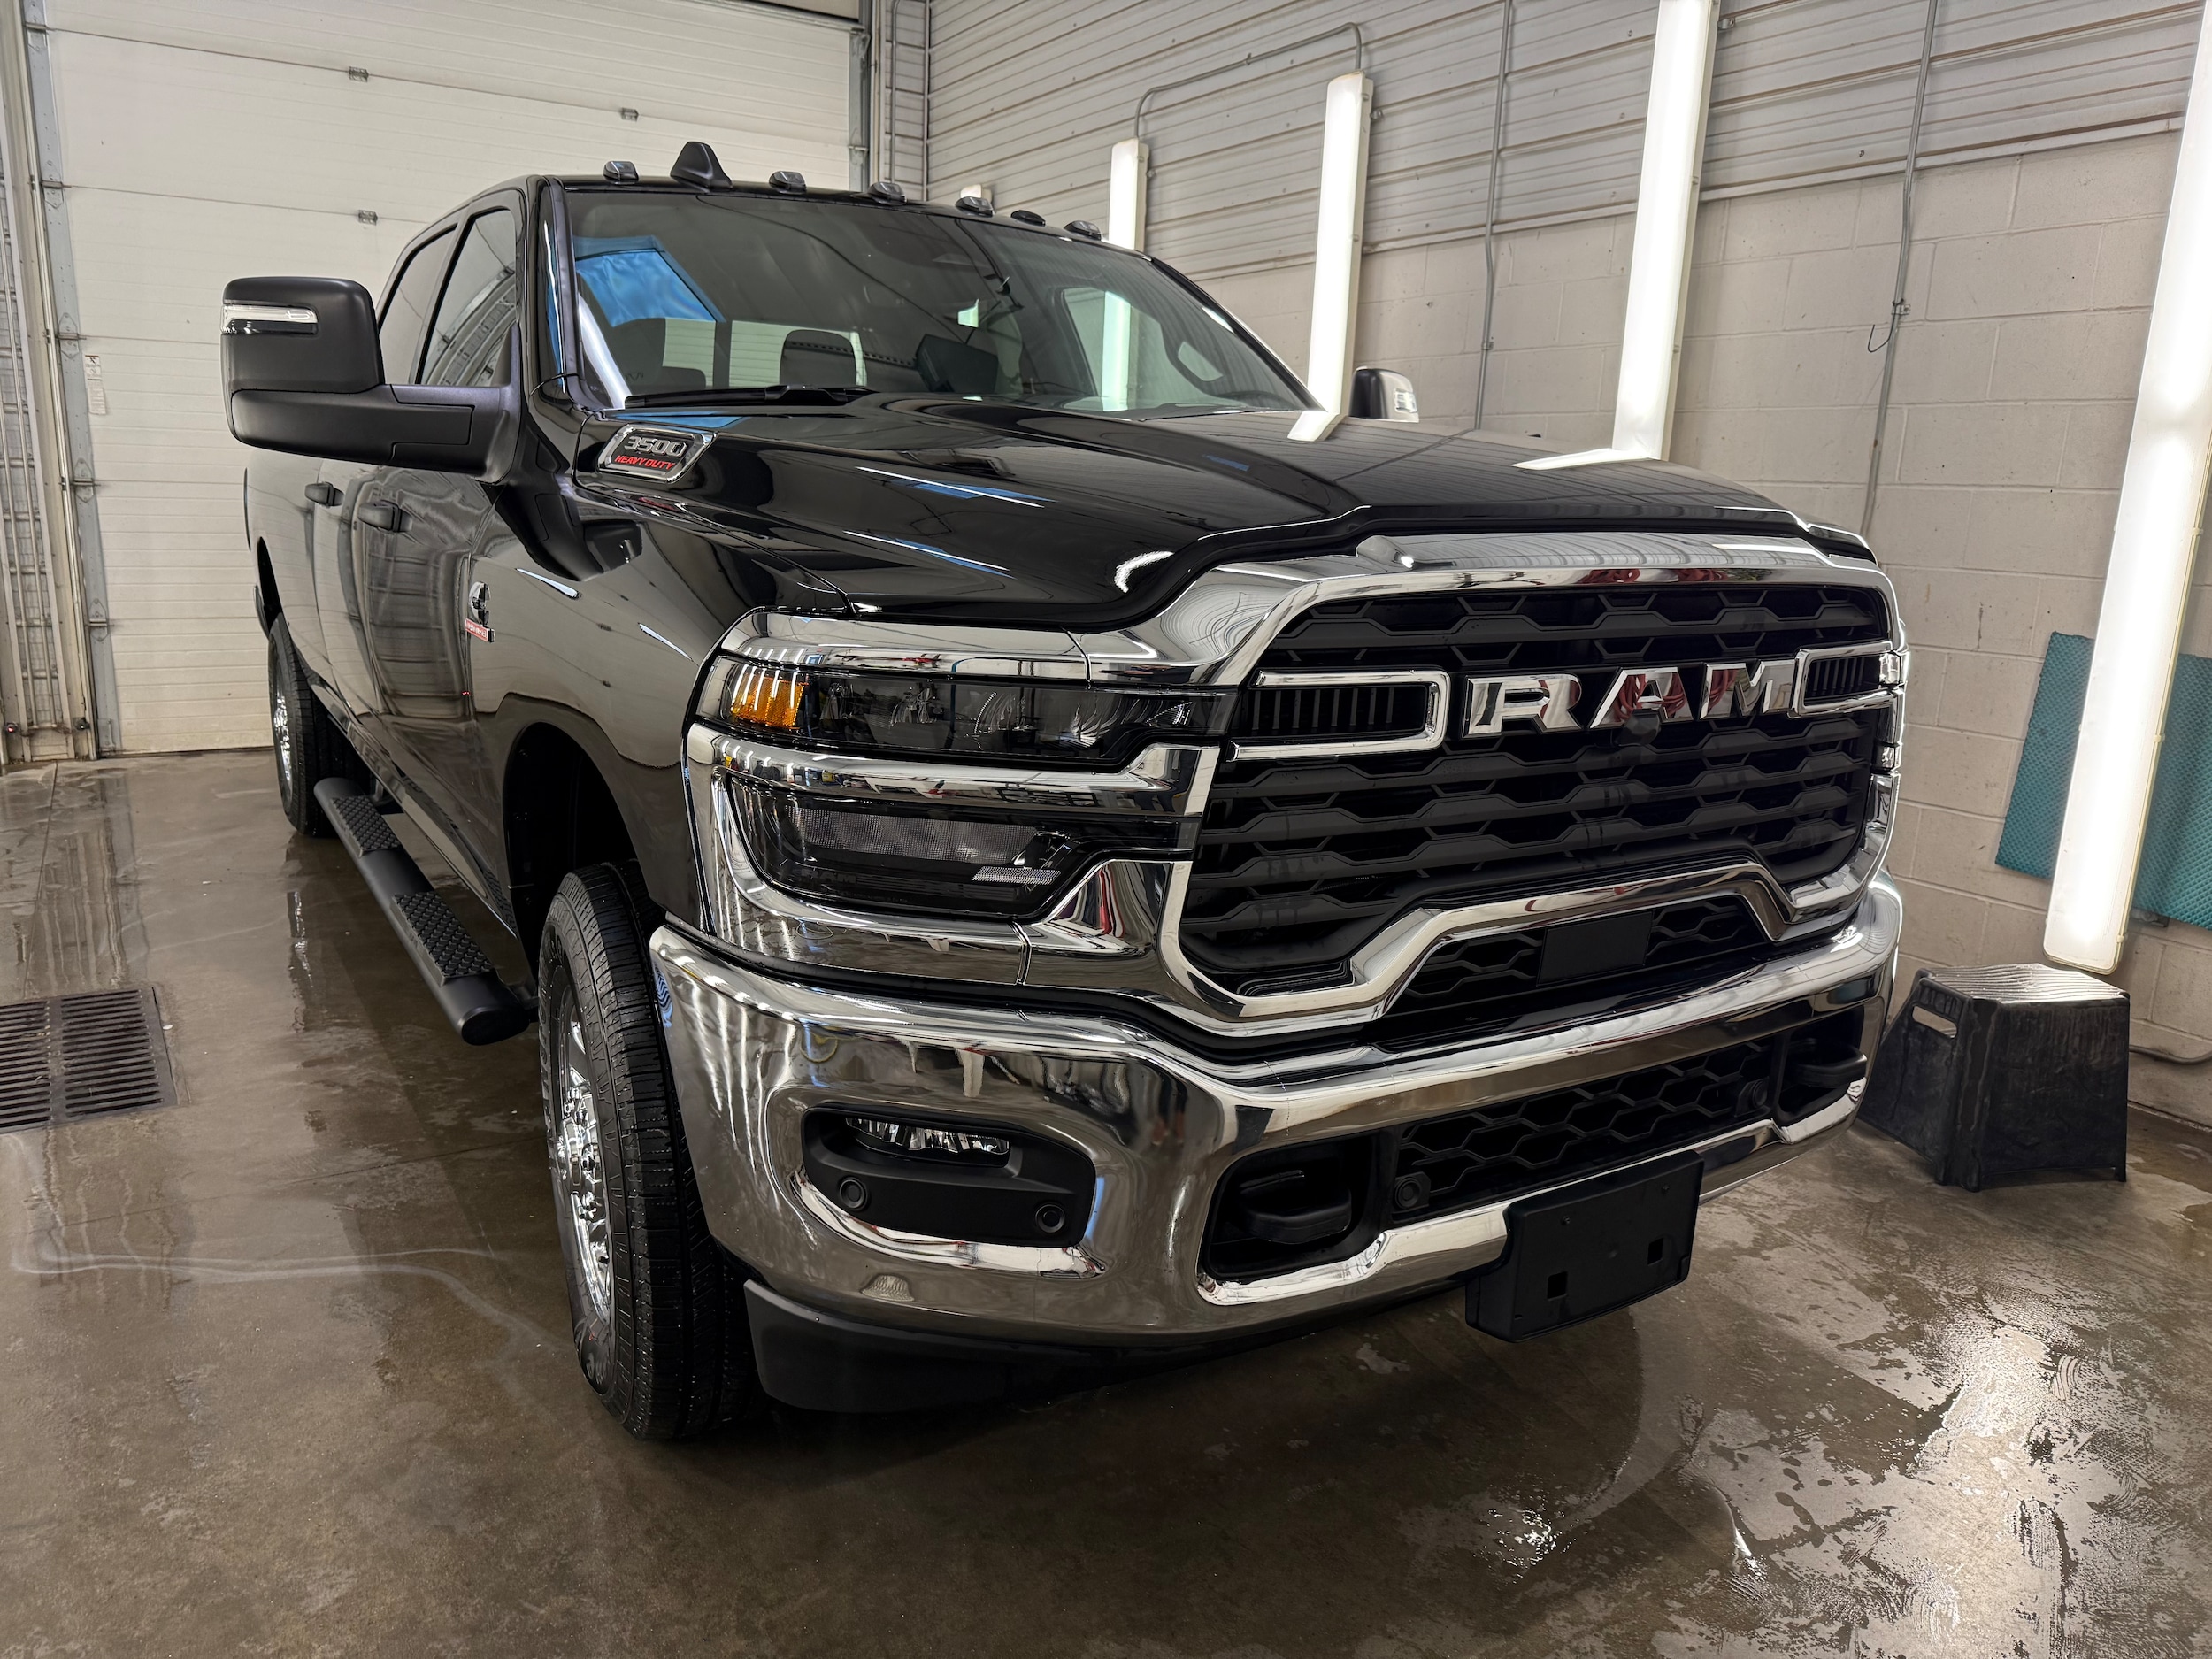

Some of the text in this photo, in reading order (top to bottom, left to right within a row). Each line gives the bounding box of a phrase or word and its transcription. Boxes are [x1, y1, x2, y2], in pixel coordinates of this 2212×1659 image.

[624, 435, 687, 457] 3500
[614, 455, 676, 470] HEAVY DUTY
[1462, 658, 1795, 740] RAM
